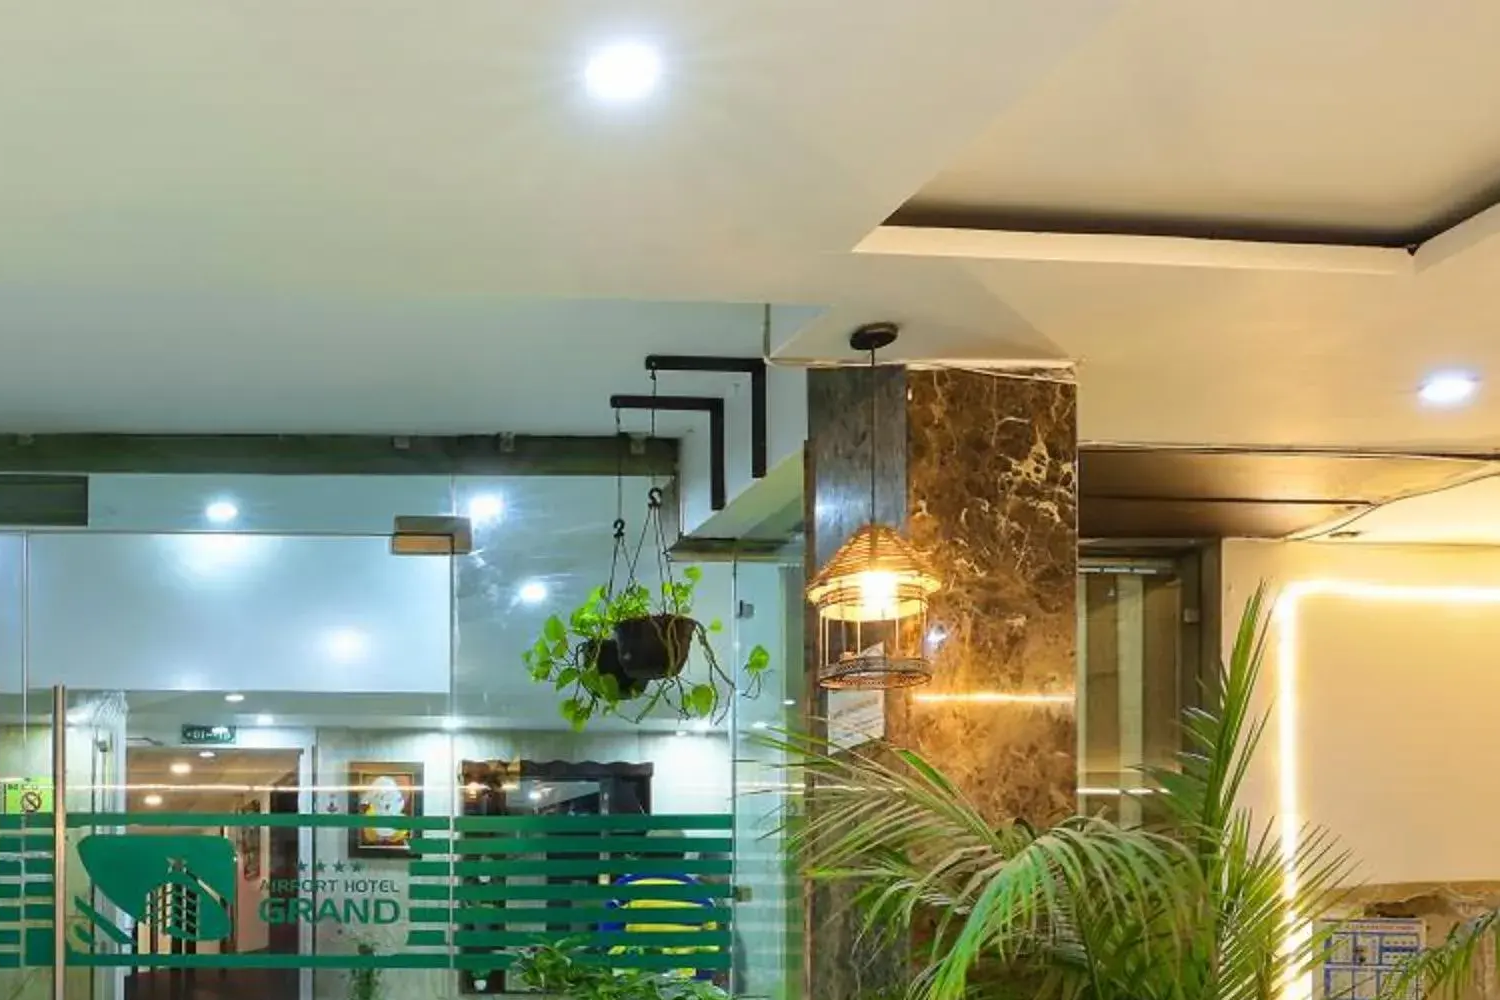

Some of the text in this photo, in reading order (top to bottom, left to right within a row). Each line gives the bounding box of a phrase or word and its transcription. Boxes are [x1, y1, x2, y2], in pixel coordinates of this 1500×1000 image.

[260, 879, 400, 893] AIRPORT HOTEL
[259, 897, 401, 924] GRAND
